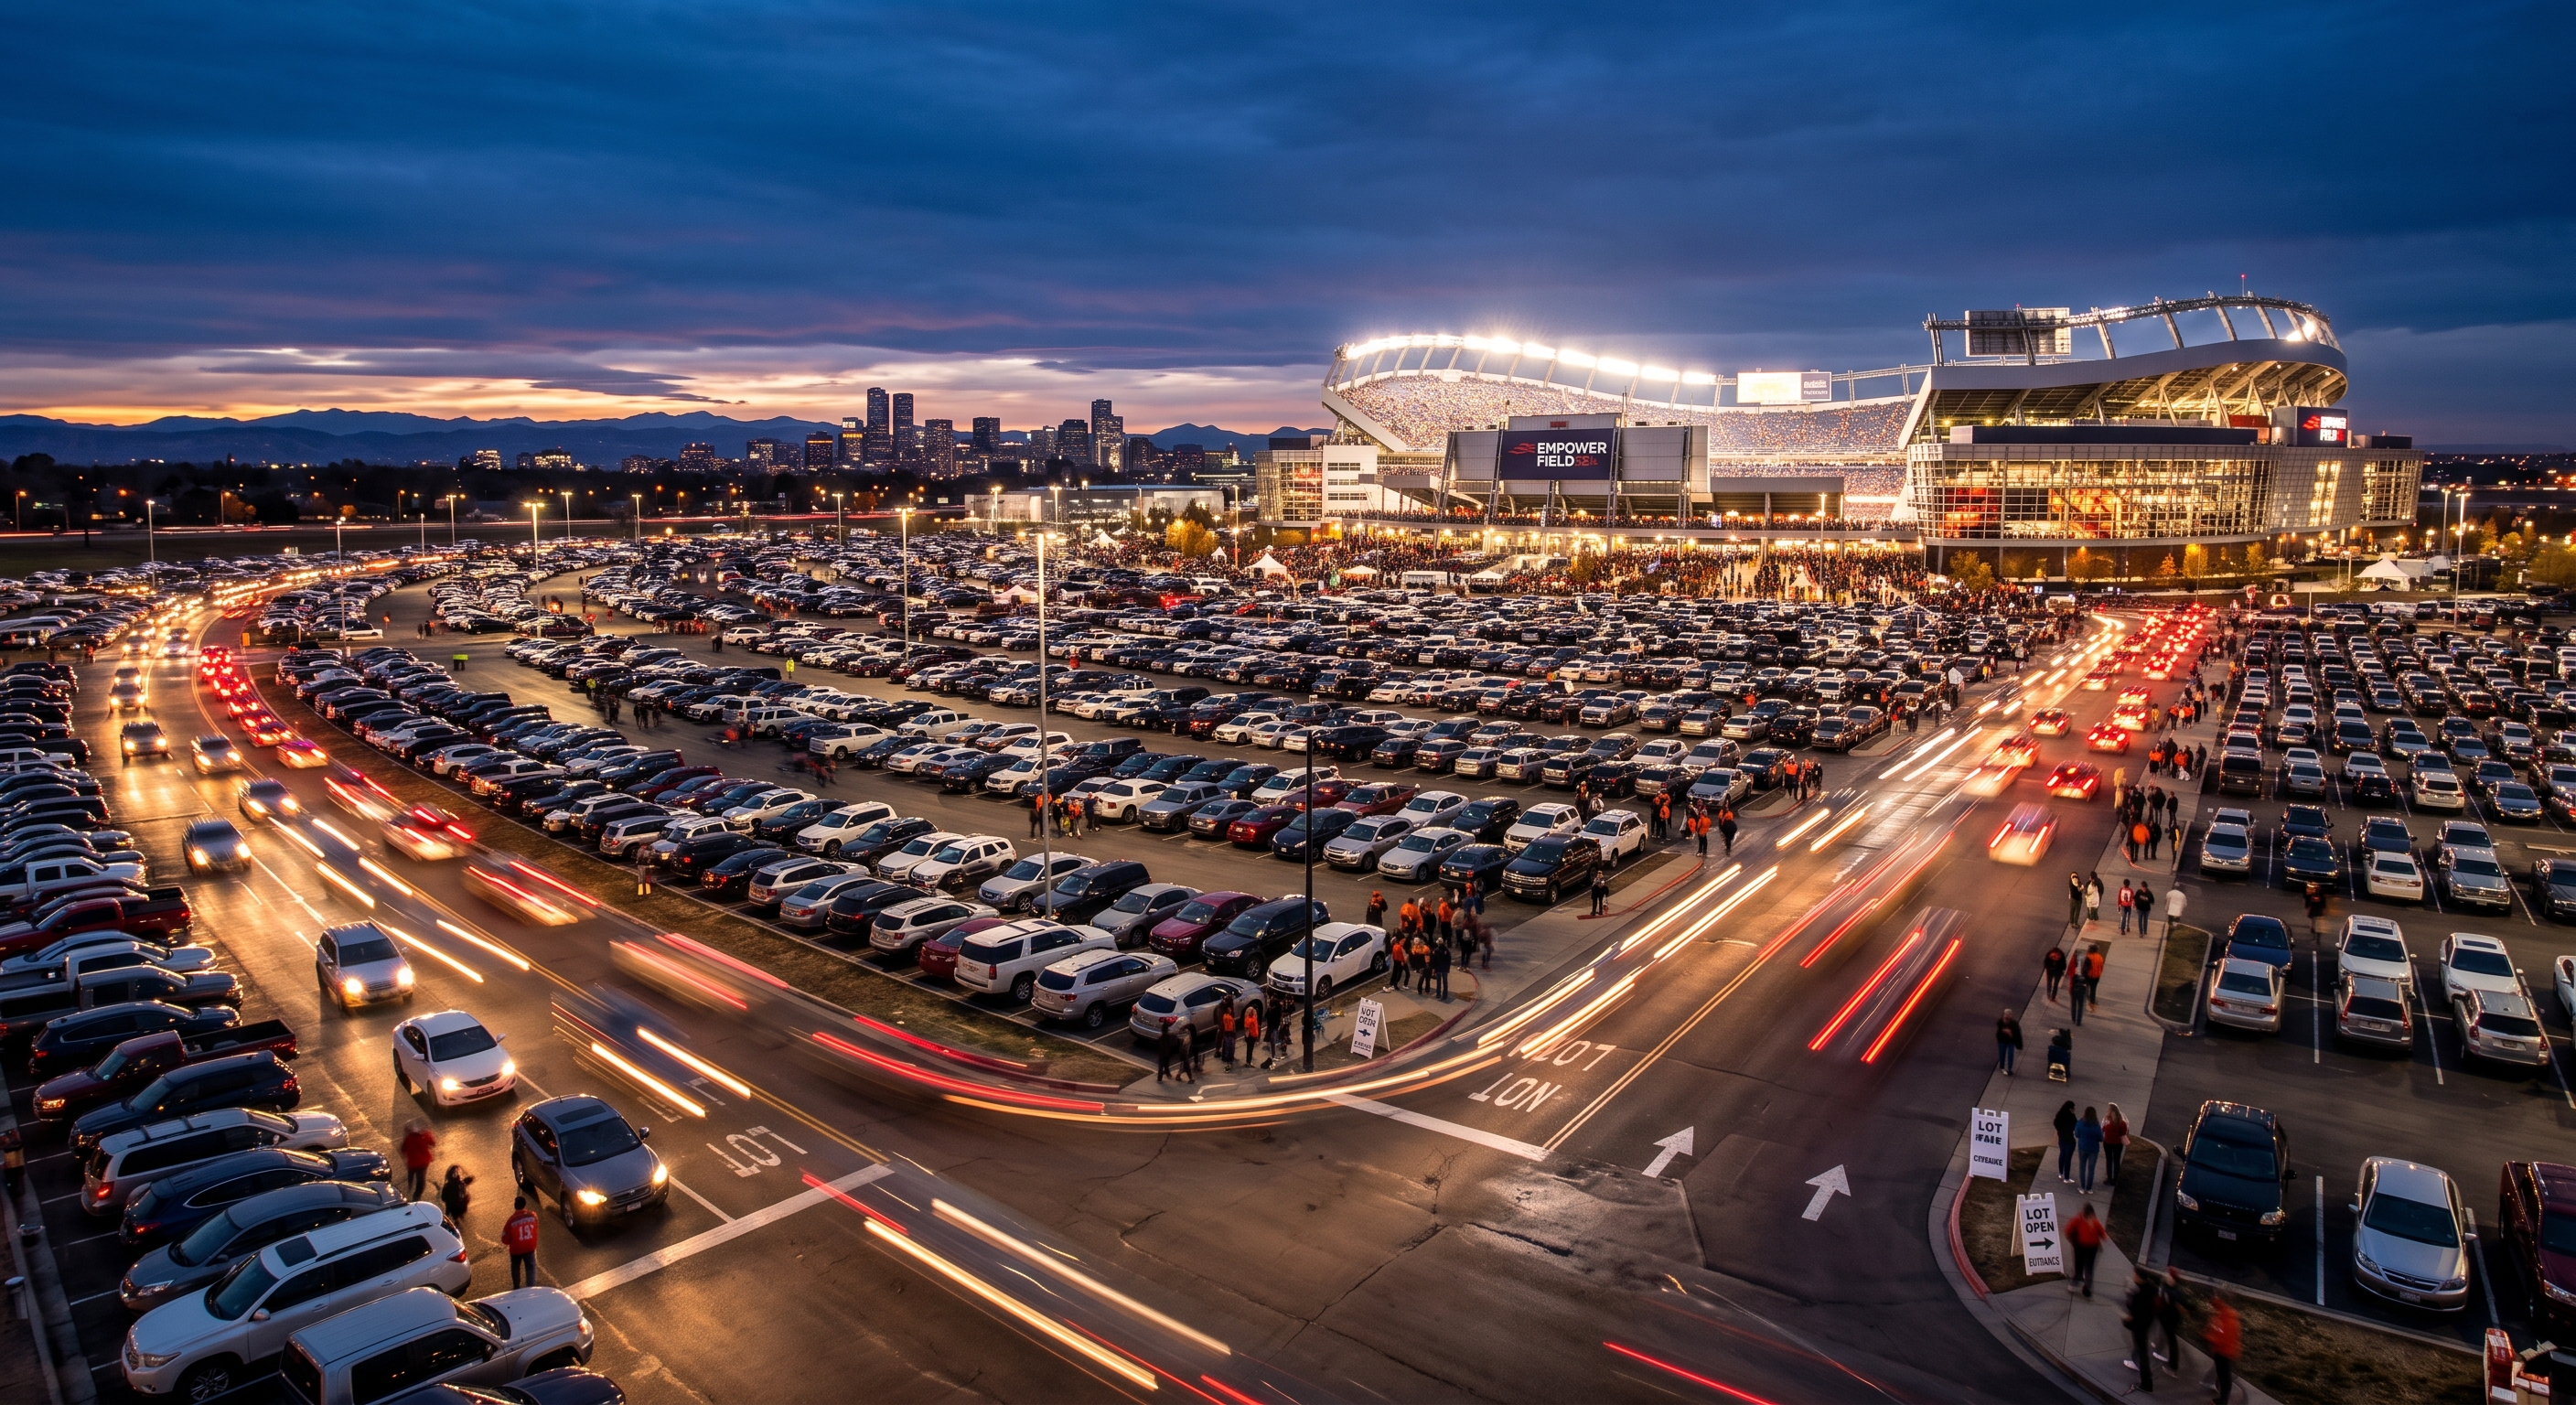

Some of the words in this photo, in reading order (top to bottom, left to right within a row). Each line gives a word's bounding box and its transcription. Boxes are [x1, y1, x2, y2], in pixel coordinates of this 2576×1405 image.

[1537, 442, 1607, 454] EMPOWER
[1537, 456, 1575, 467] FIELD
[1361, 1007, 1376, 1017] NOT
[1978, 1121, 2002, 1133] LOT
[2025, 1207, 2050, 1220] LOT
[2025, 1221, 2055, 1233] OPEN
